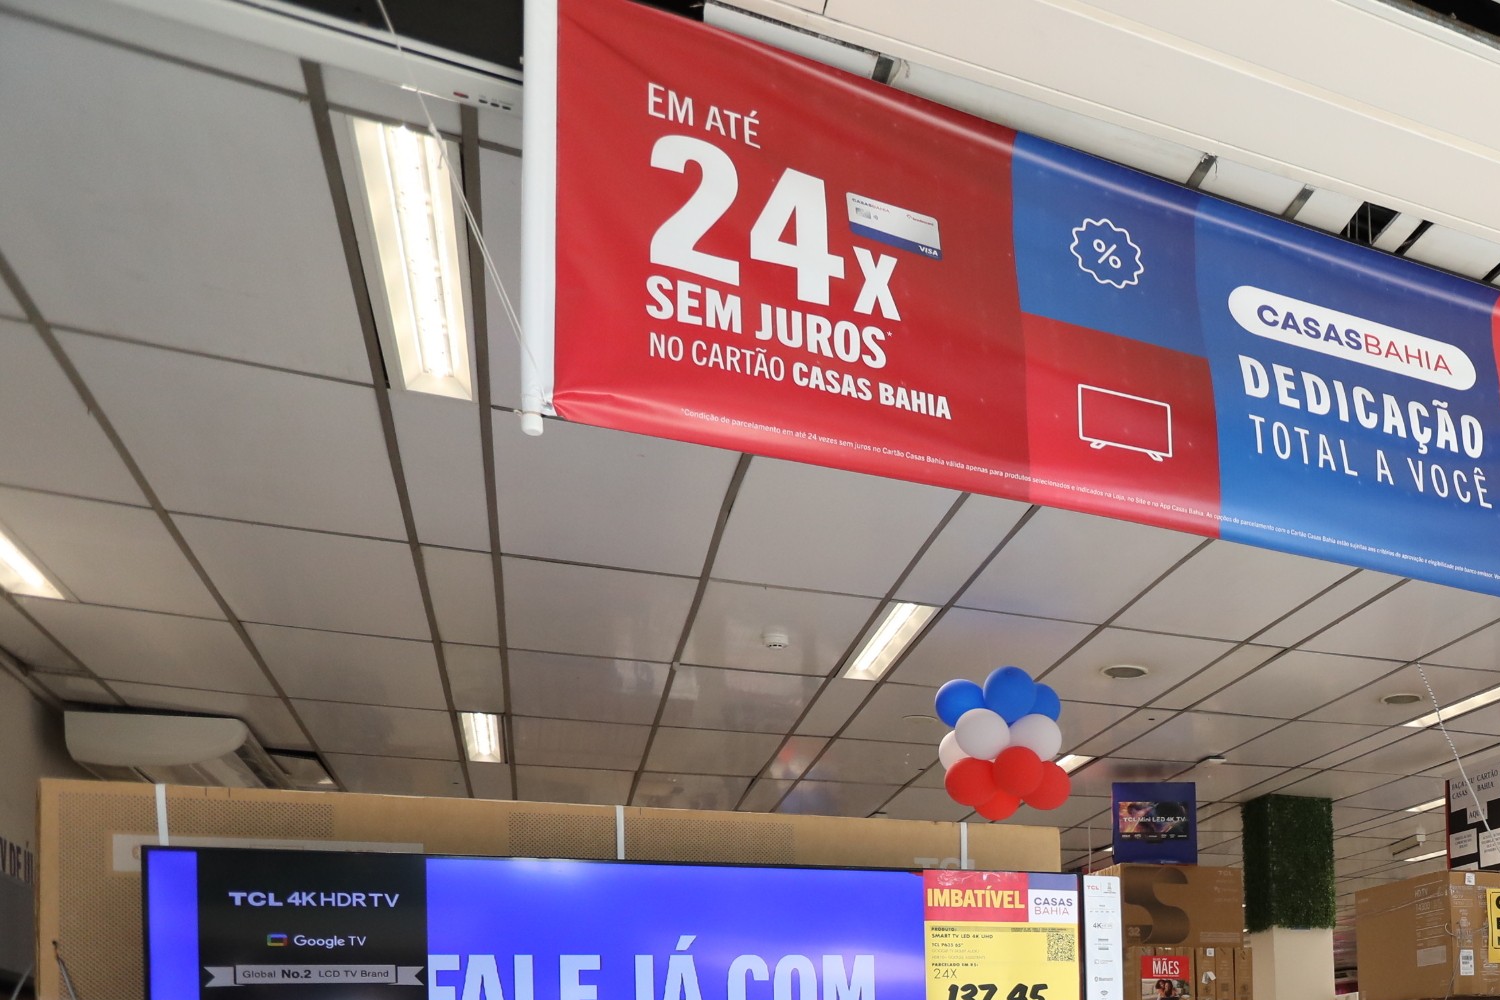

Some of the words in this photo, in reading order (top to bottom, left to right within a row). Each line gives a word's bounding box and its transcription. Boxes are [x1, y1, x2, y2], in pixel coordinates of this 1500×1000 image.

[648, 82, 694, 126] EM
[705, 110, 761, 149] ATÉ
[918, 244, 939, 257] VISA
[645, 274, 742, 334] SEM
[649, 331, 684, 362] NO
[691, 340, 785, 382] CARTÃO
[792, 362, 873, 401] CASAS
[878, 382, 952, 420] BAHIA
[1238, 354, 1484, 459] DEDICAÇÃO
[731, 418, 782, 435] parcelamento
[782, 429, 794, 437] em
[794, 430, 807, 439] até
[808, 433, 817, 441] 24
[818, 436, 838, 446] vezes
[839, 440, 853, 448] sem
[854, 442, 871, 453] juros
[882, 446, 904, 458] Cartão
[905, 451, 925, 462] Casas
[926, 454, 945, 465] Bahia
[1248, 413, 1358, 477] TOTAL
[1376, 449, 1394, 485] A
[1407, 457, 1493, 509] VOCÊ
[228, 891, 283, 907] TCL
[369, 893, 400, 907] TV
[927, 885, 1026, 909] IMBATÍVEL
[1034, 897, 1073, 907] CASAS
[1034, 906, 1070, 915] BAHIA
[293, 934, 346, 949] Google
[348, 936, 367, 947] TV
[242, 969, 276, 979] Global
[281, 969, 312, 979] No.2
[319, 969, 340, 978] LCD
[343, 969, 358, 978] TV
[360, 969, 389, 978] Brand
[933, 968, 958, 979] 24X
[1152, 958, 1180, 975] MÃES
